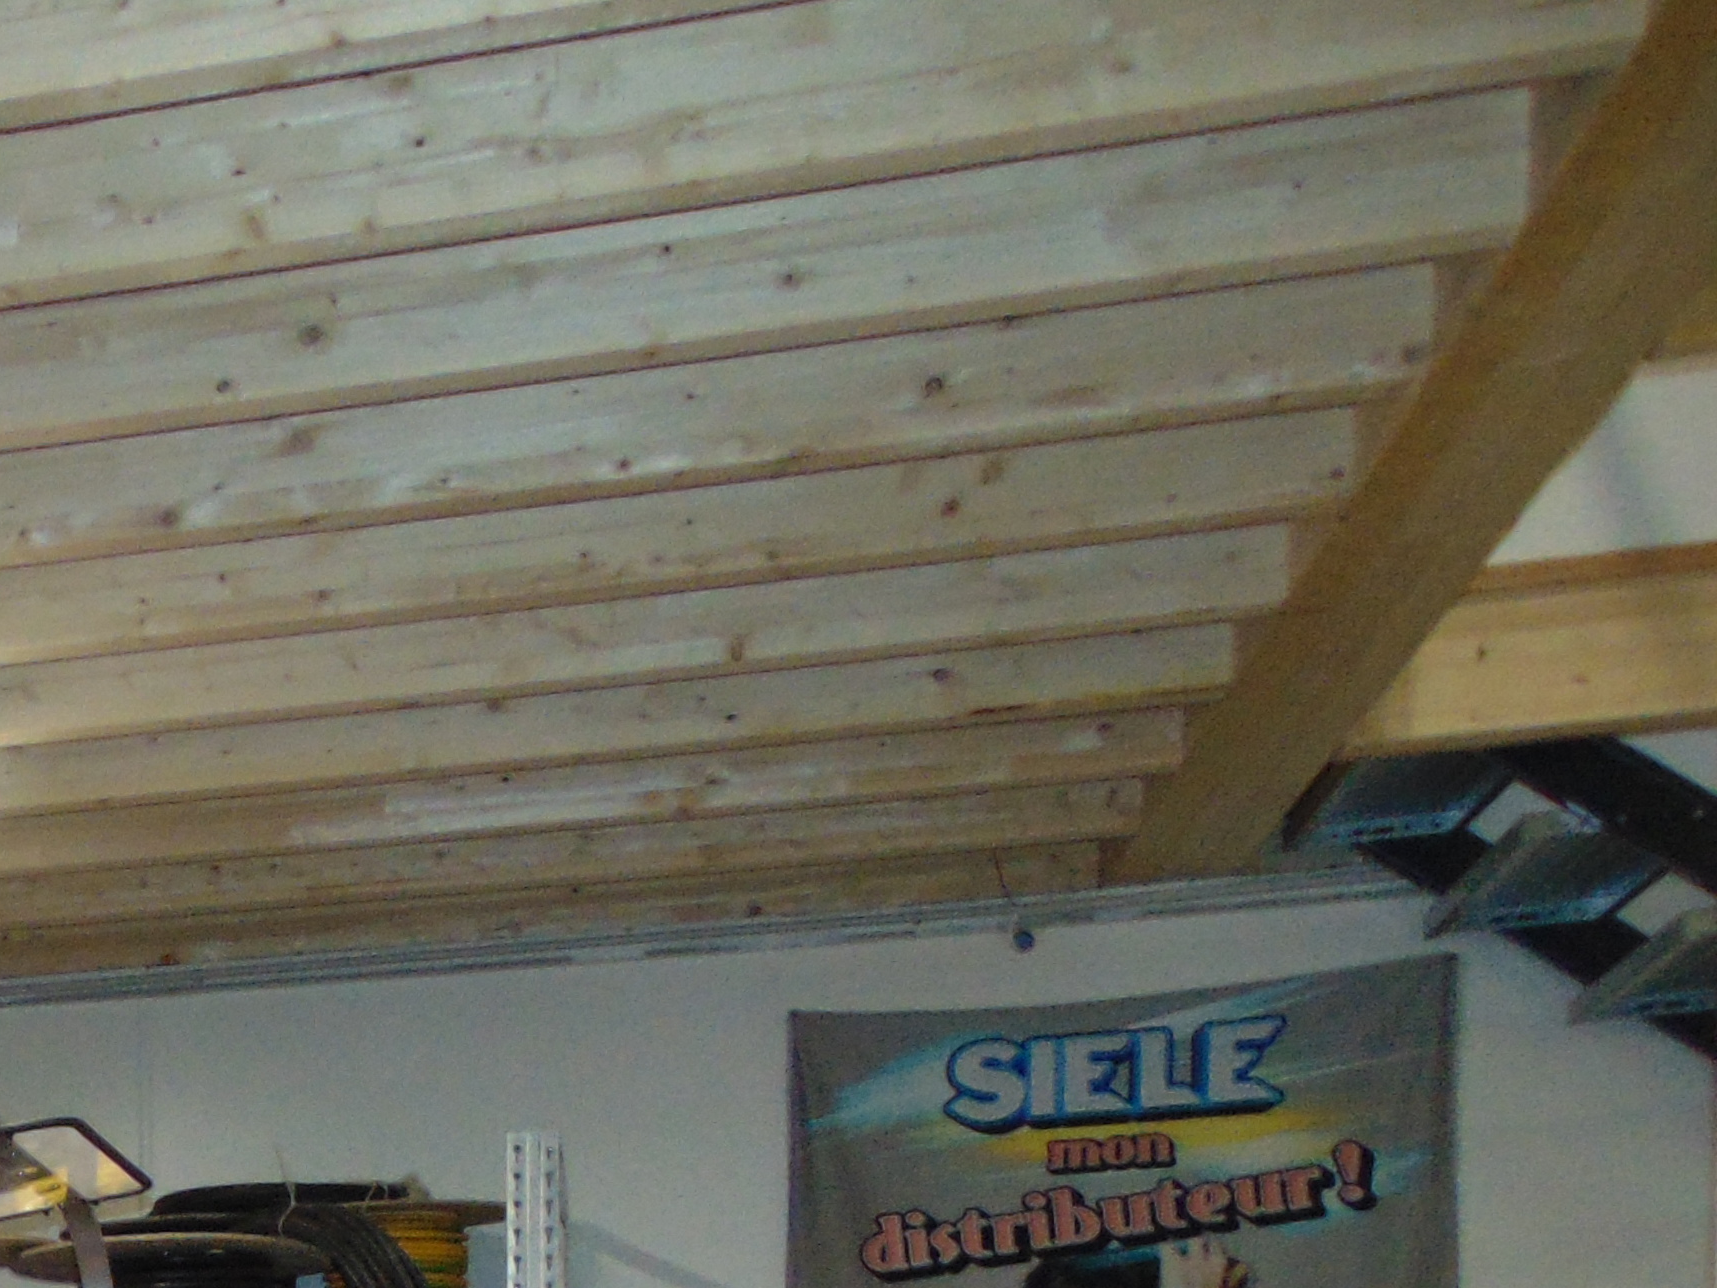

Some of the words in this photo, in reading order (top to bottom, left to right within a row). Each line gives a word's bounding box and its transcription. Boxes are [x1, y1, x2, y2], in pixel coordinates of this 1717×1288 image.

[944, 1014, 1288, 1134] SIELE
[1046, 1132, 1177, 1174] mon
[862, 1163, 1335, 1284] distributeur
